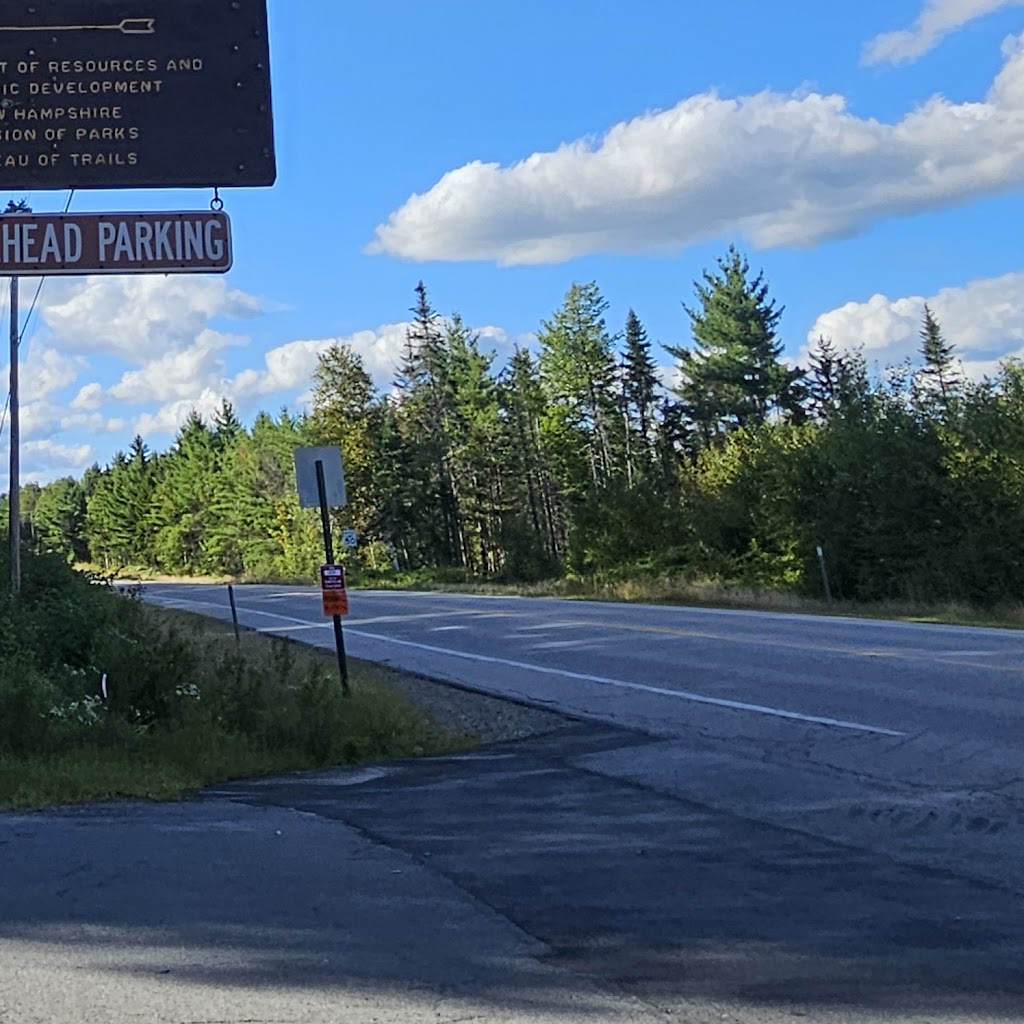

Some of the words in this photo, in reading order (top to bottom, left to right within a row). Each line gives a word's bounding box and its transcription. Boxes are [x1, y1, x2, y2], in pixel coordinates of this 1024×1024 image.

[17, 61, 39, 73] OF
[48, 59, 158, 73] RESOURCES
[166, 58, 203, 71] AND
[30, 80, 163, 95] DEVELOPMENT
[14, 107, 122, 120] HAMPSHIRE
[45, 129, 67, 140] OF
[76, 127, 139, 140] PARKS
[38, 154, 60, 166] OF
[71, 153, 138, 165] TRAILS
[98, 219, 223, 262] PARKING
